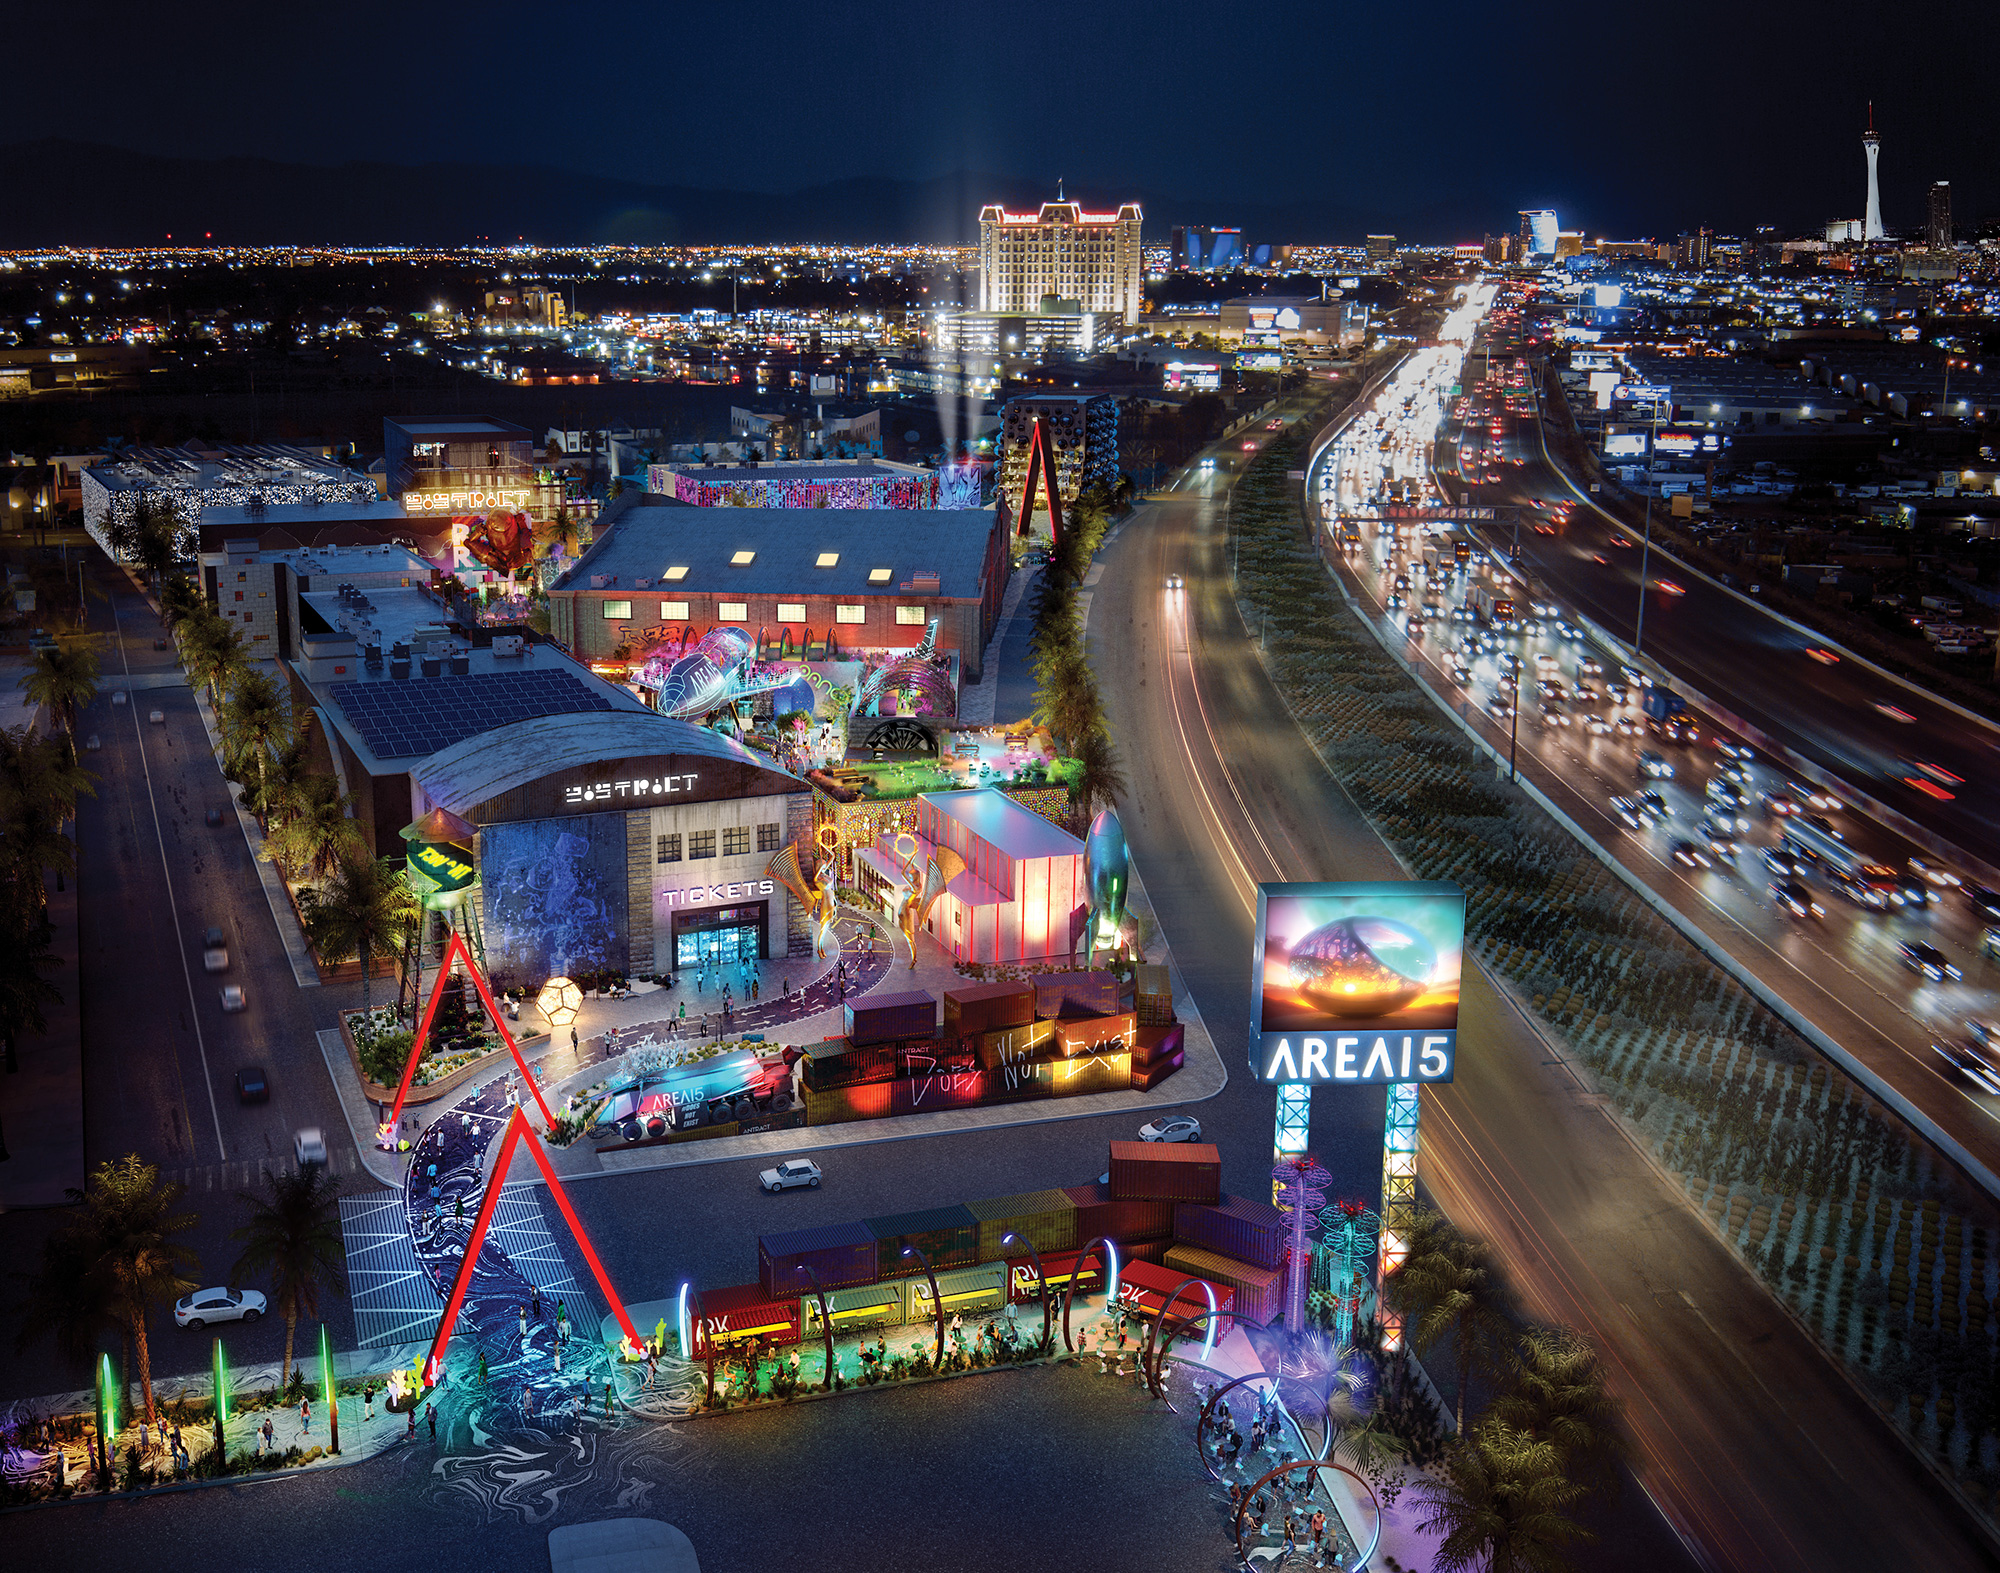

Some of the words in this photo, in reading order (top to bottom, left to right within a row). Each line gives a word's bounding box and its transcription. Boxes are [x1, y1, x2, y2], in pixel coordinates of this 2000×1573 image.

[565, 773, 698, 803] DISTRICT
[663, 879, 774, 905] TICKETS
[1266, 1036, 1448, 1079] AREA15
[652, 1087, 705, 1110] AREA15
